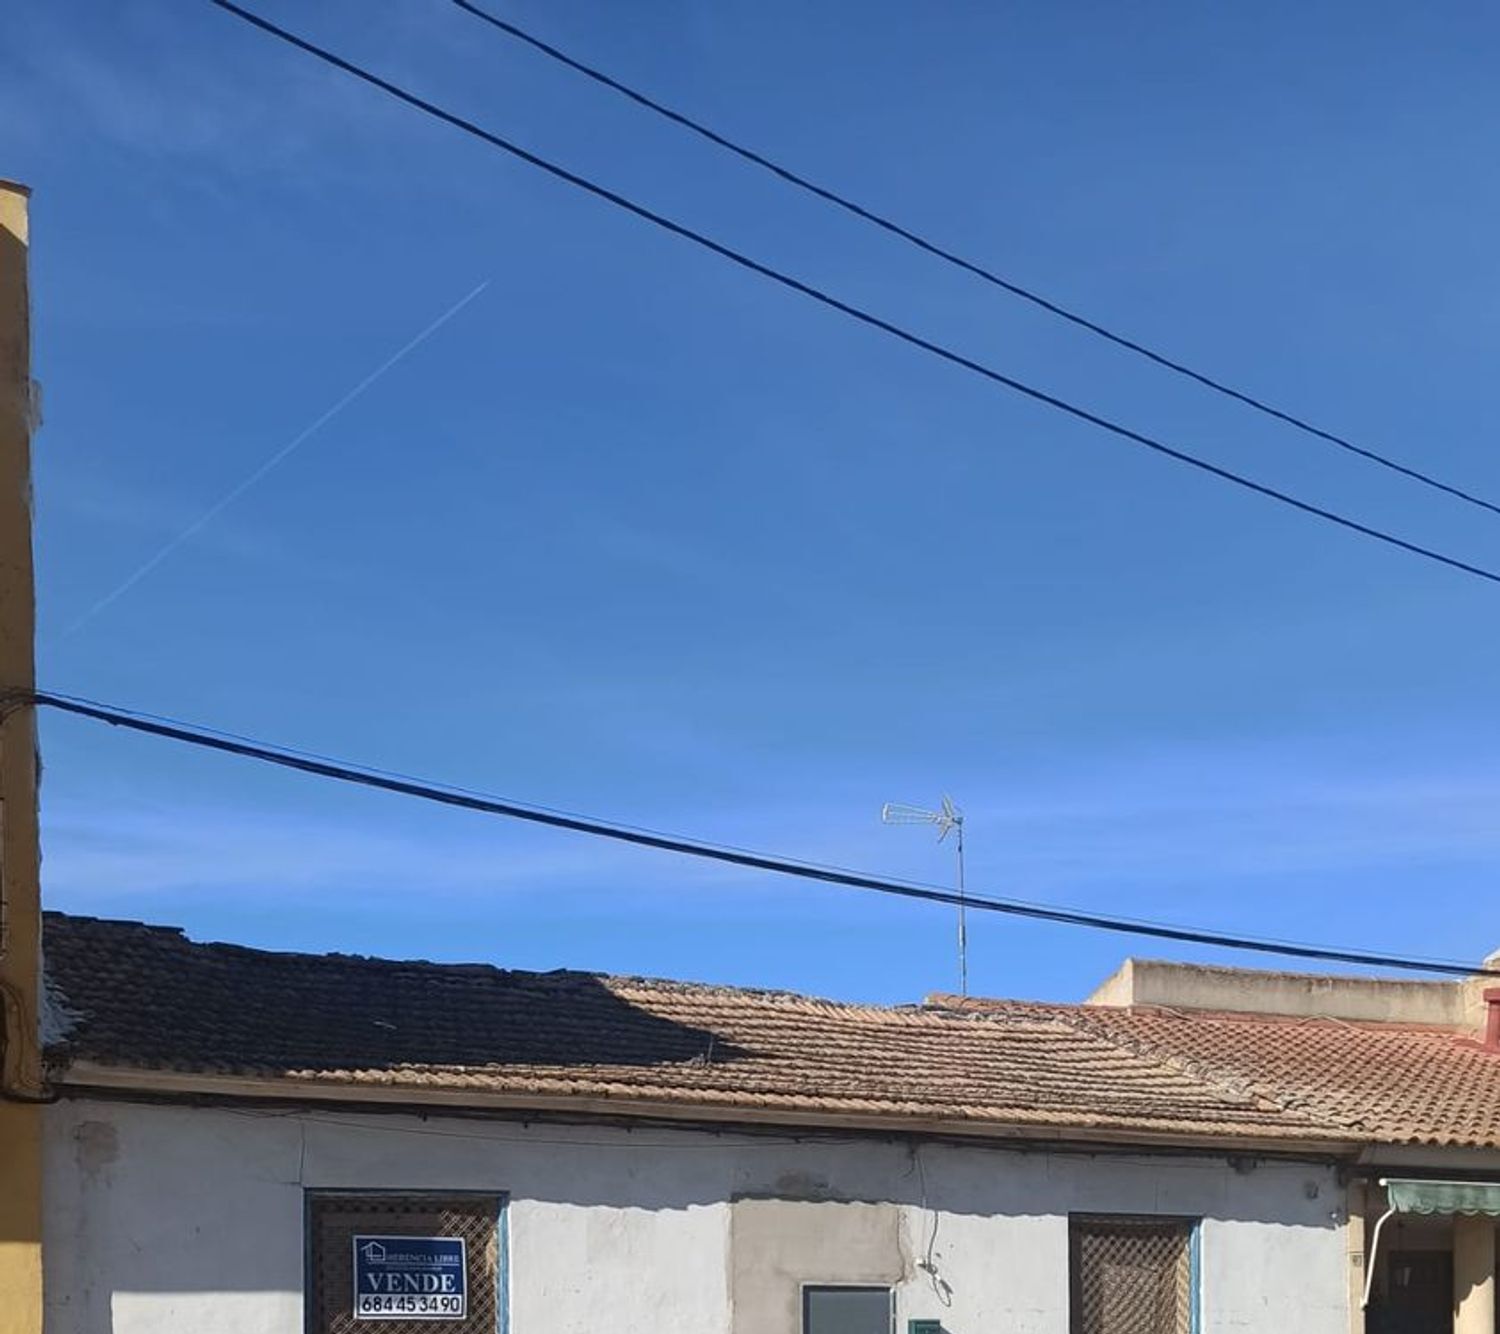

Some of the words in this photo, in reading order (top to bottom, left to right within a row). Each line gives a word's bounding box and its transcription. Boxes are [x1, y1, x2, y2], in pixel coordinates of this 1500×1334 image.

[434, 1254, 460, 1263] LIBRE
[366, 1272, 457, 1293] VENDE
[361, 1296, 393, 1312] 684
[396, 1296, 416, 1312] 45
[419, 1296, 438, 1312] 34
[441, 1296, 460, 1312] 90
